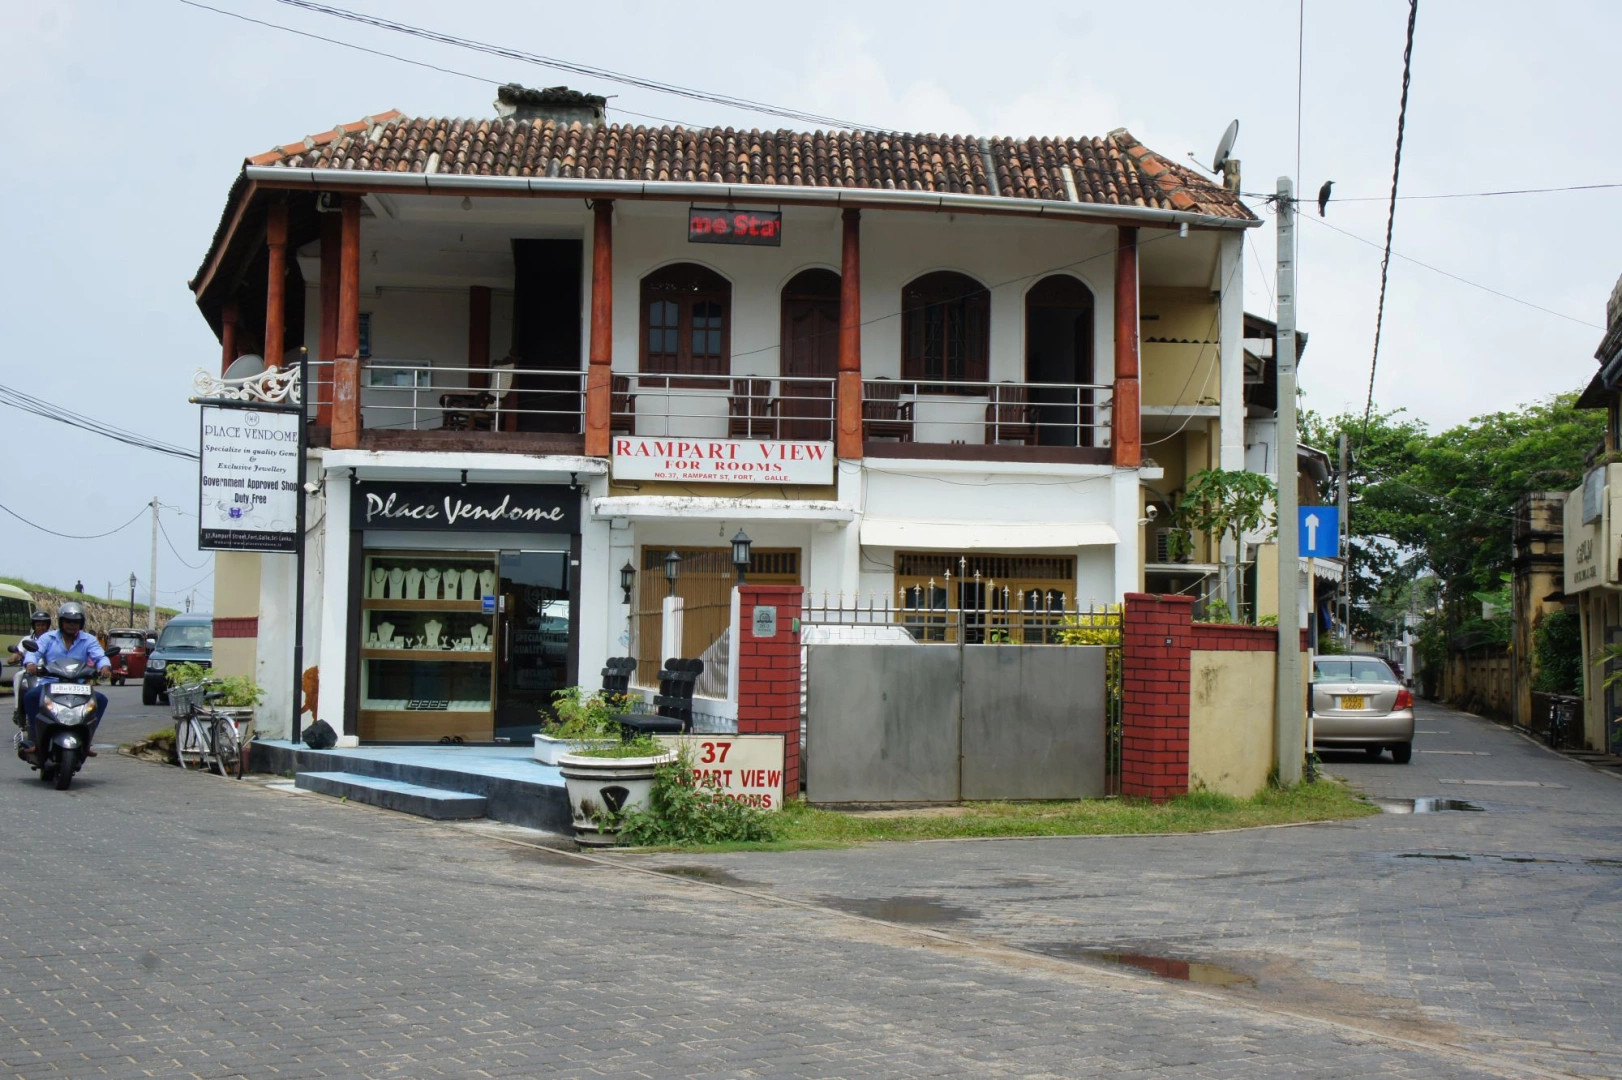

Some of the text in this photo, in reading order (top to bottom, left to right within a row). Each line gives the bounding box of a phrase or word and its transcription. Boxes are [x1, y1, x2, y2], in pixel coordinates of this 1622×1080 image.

[205, 425, 297, 442] PLACE VENDOME
[205, 444, 241, 453] Specialize
[252, 448, 277, 456] quality
[616, 440, 828, 461] RAMPART VIEW
[217, 463, 287, 473] Exclusive Jewellery
[665, 460, 783, 472] FOR ROOMS
[203, 476, 298, 492] Government Approved Shop
[235, 493, 267, 504] Duty Free
[366, 493, 564, 525] Place Vendome
[700, 742, 732, 763] 37
[680, 769, 781, 788] PART VIEW
